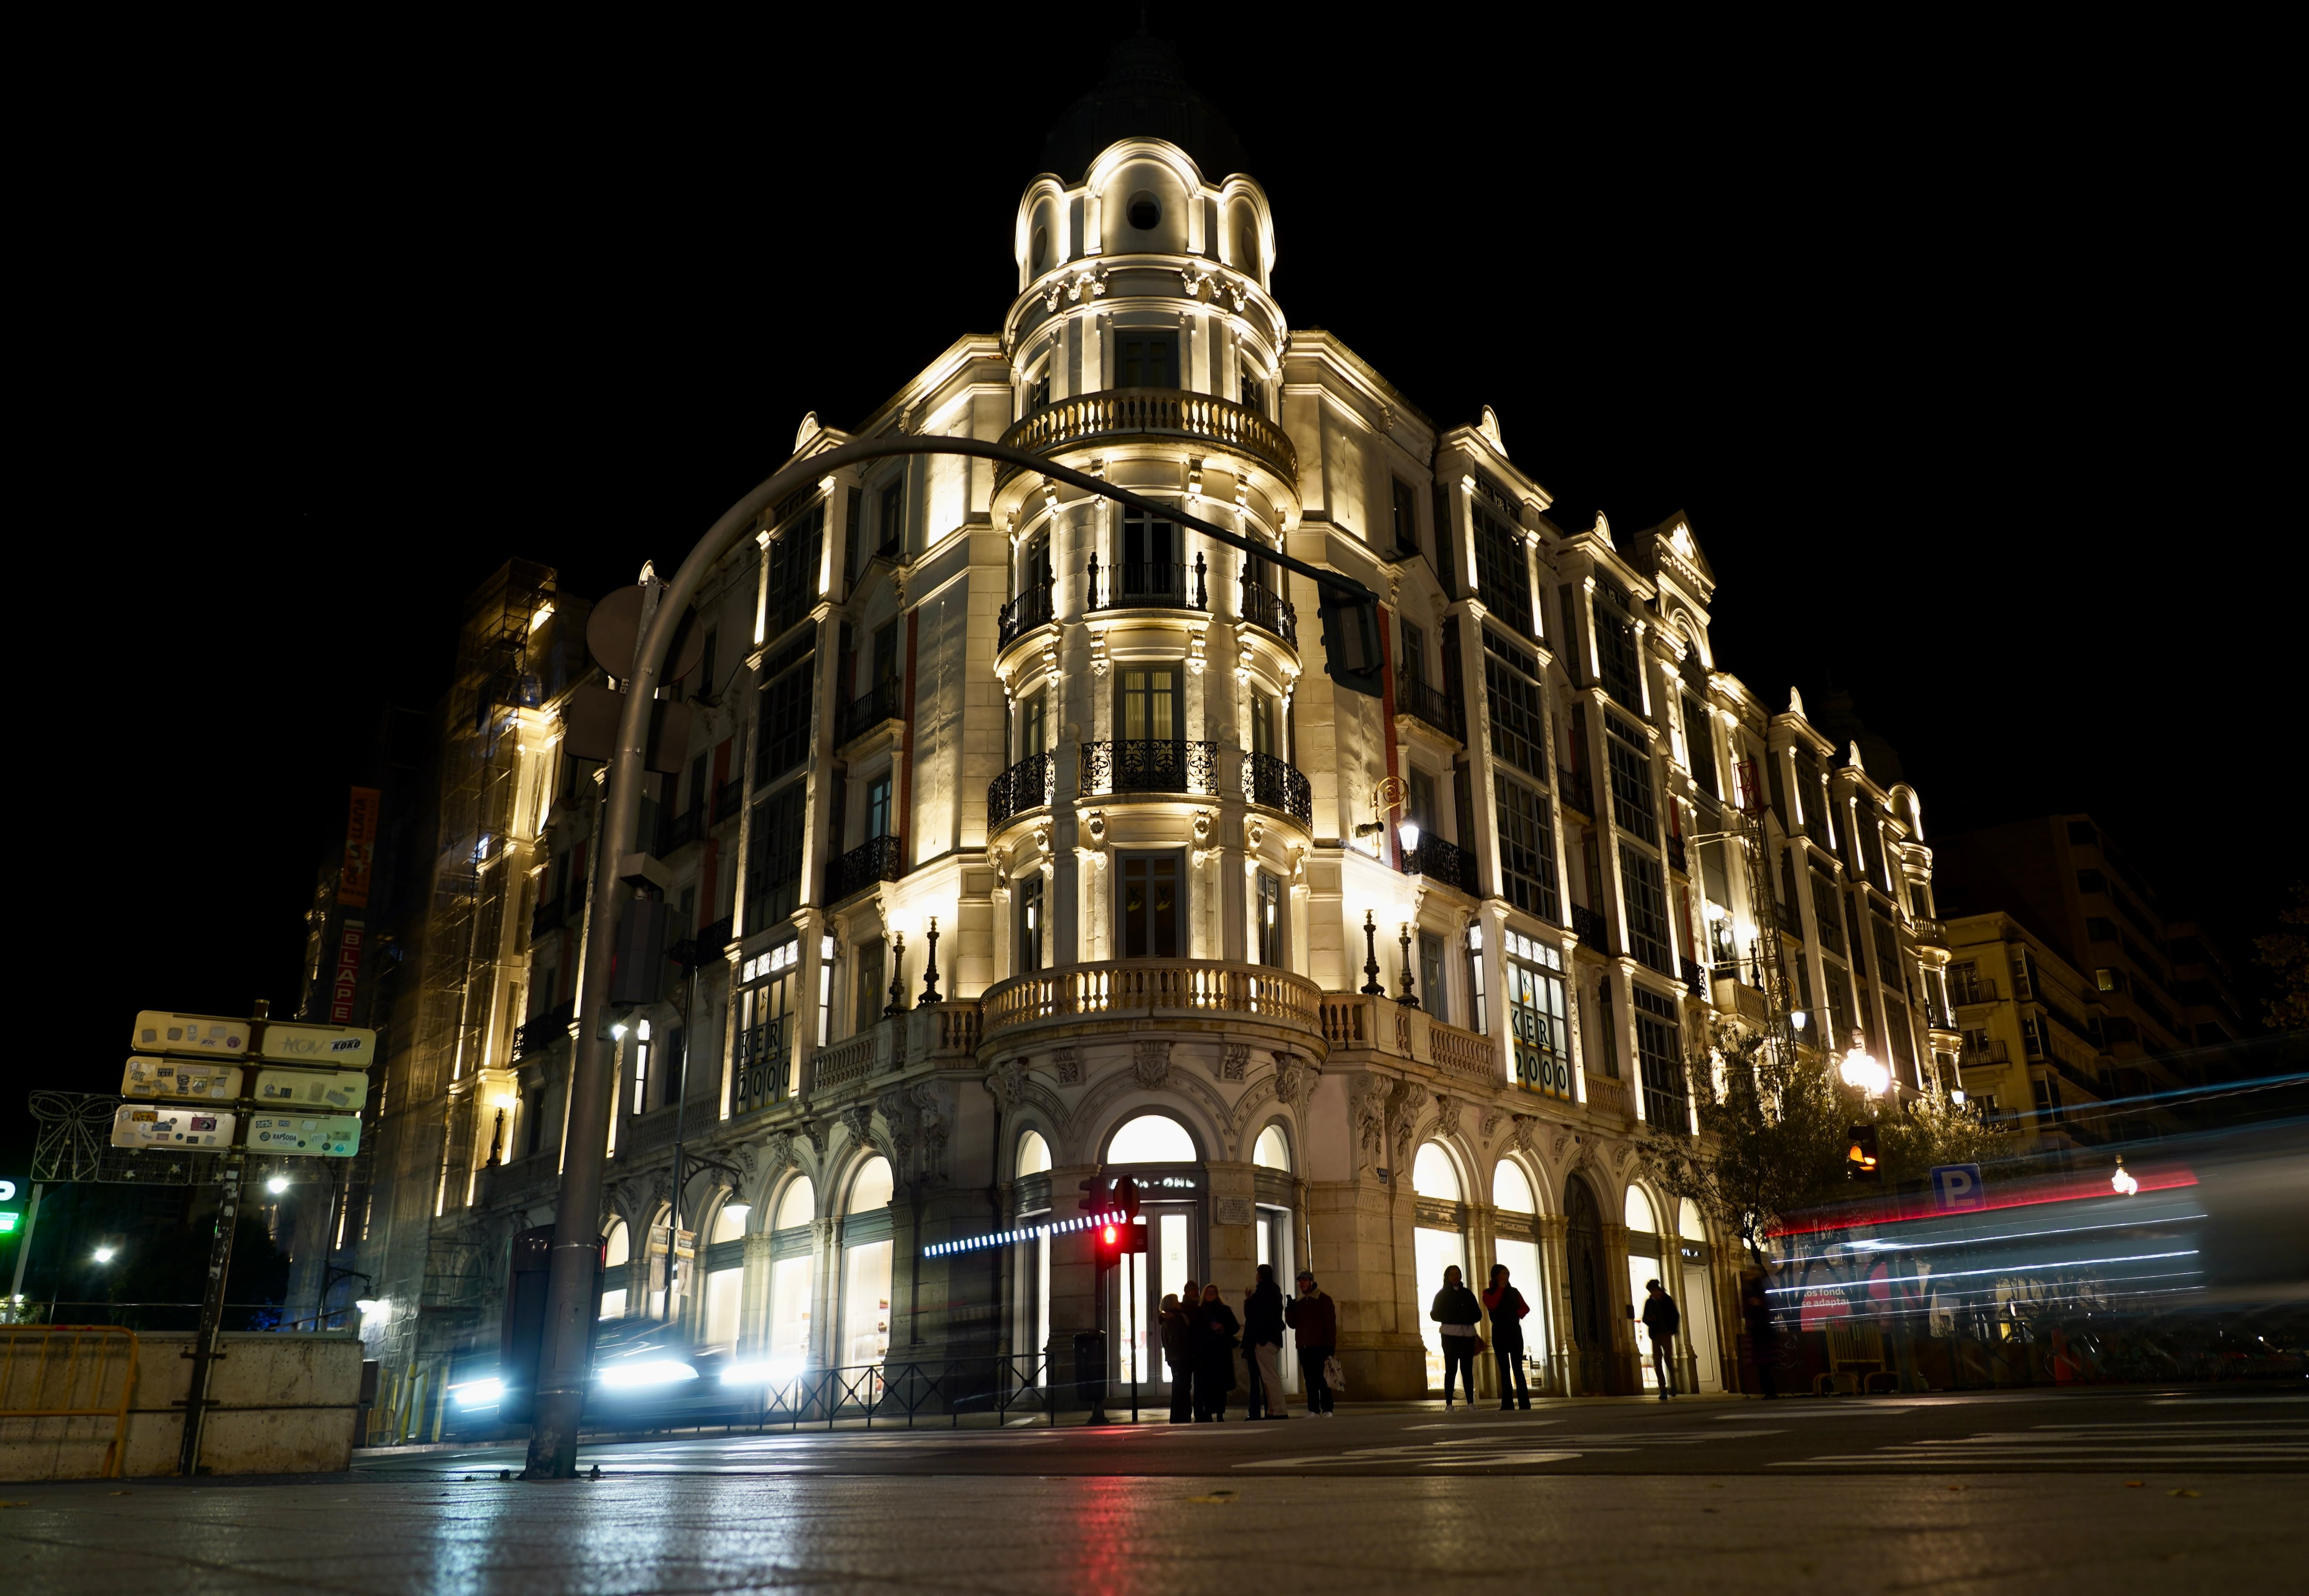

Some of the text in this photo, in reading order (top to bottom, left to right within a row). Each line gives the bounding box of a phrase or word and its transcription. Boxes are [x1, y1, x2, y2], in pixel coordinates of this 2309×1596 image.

[350, 844, 361, 860] LA
[334, 933, 360, 1019] BLAPE
[332, 1040, 361, 1051] KOKO
[739, 1061, 790, 1102] 2000
[1515, 1051, 1566, 1090] 2000
[1941, 1170, 1972, 1207] P
